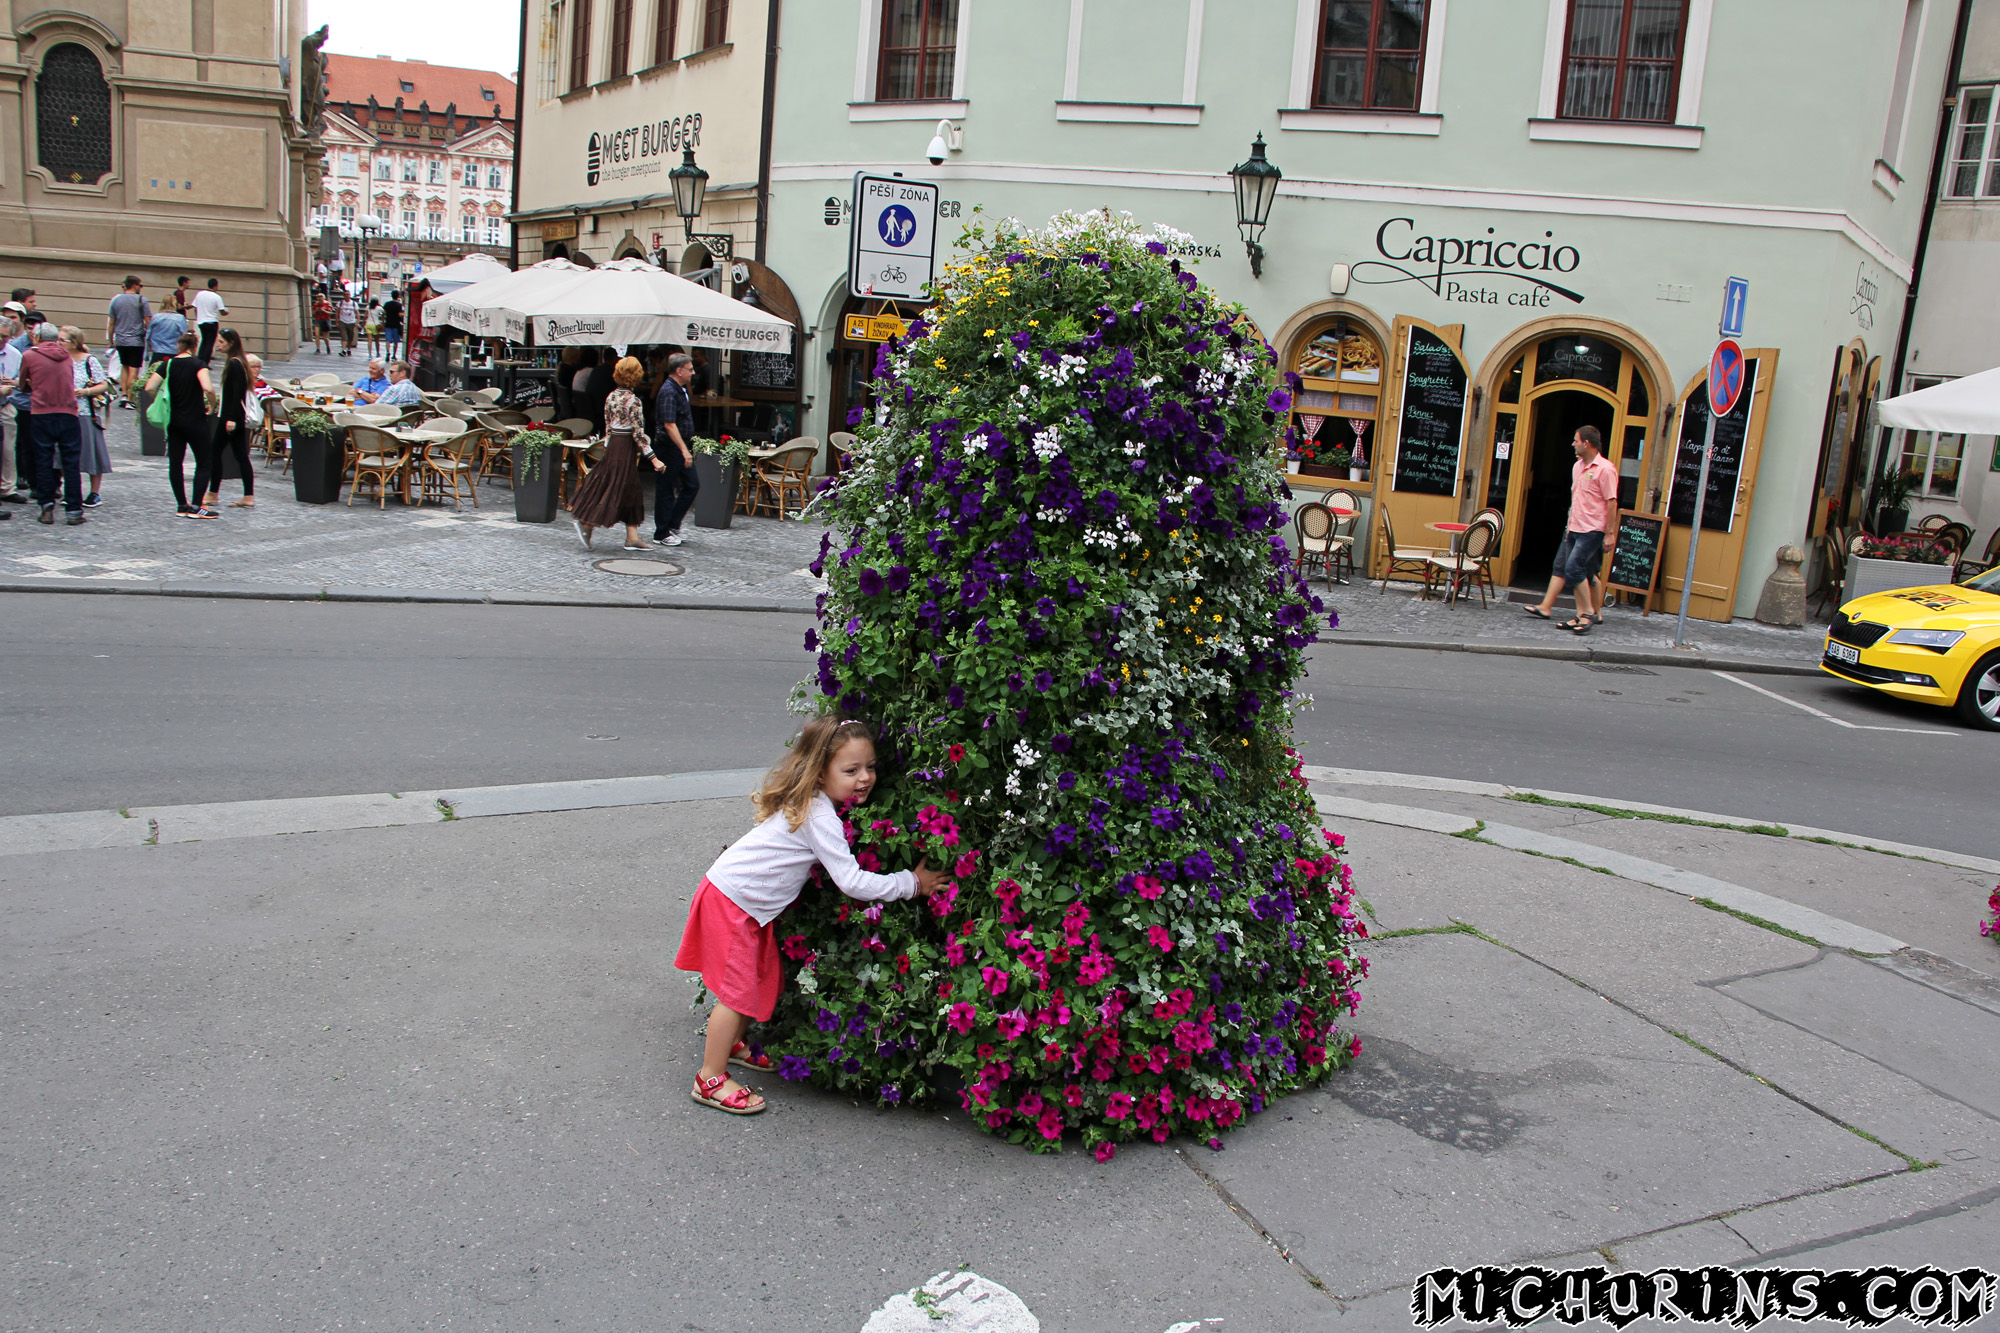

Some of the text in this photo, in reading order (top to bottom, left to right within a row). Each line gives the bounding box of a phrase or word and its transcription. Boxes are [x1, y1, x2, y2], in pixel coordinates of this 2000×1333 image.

[602, 112, 703, 165] MEET BURGER
[869, 183, 930, 203] PĚŠÍ ZÓNA
[419, 226, 504, 247] RICHTER
[1376, 217, 1581, 296] Capriccio
[1445, 281, 1551, 308] Pasta café
[547, 319, 605, 342] Pilsner Urquell
[700, 326, 780, 342] MEET BURGER
[873, 321, 898, 331] VINOHRADY
[1554, 349, 1602, 367] Capriccio
[1842, 646, 1856, 661] 6368
